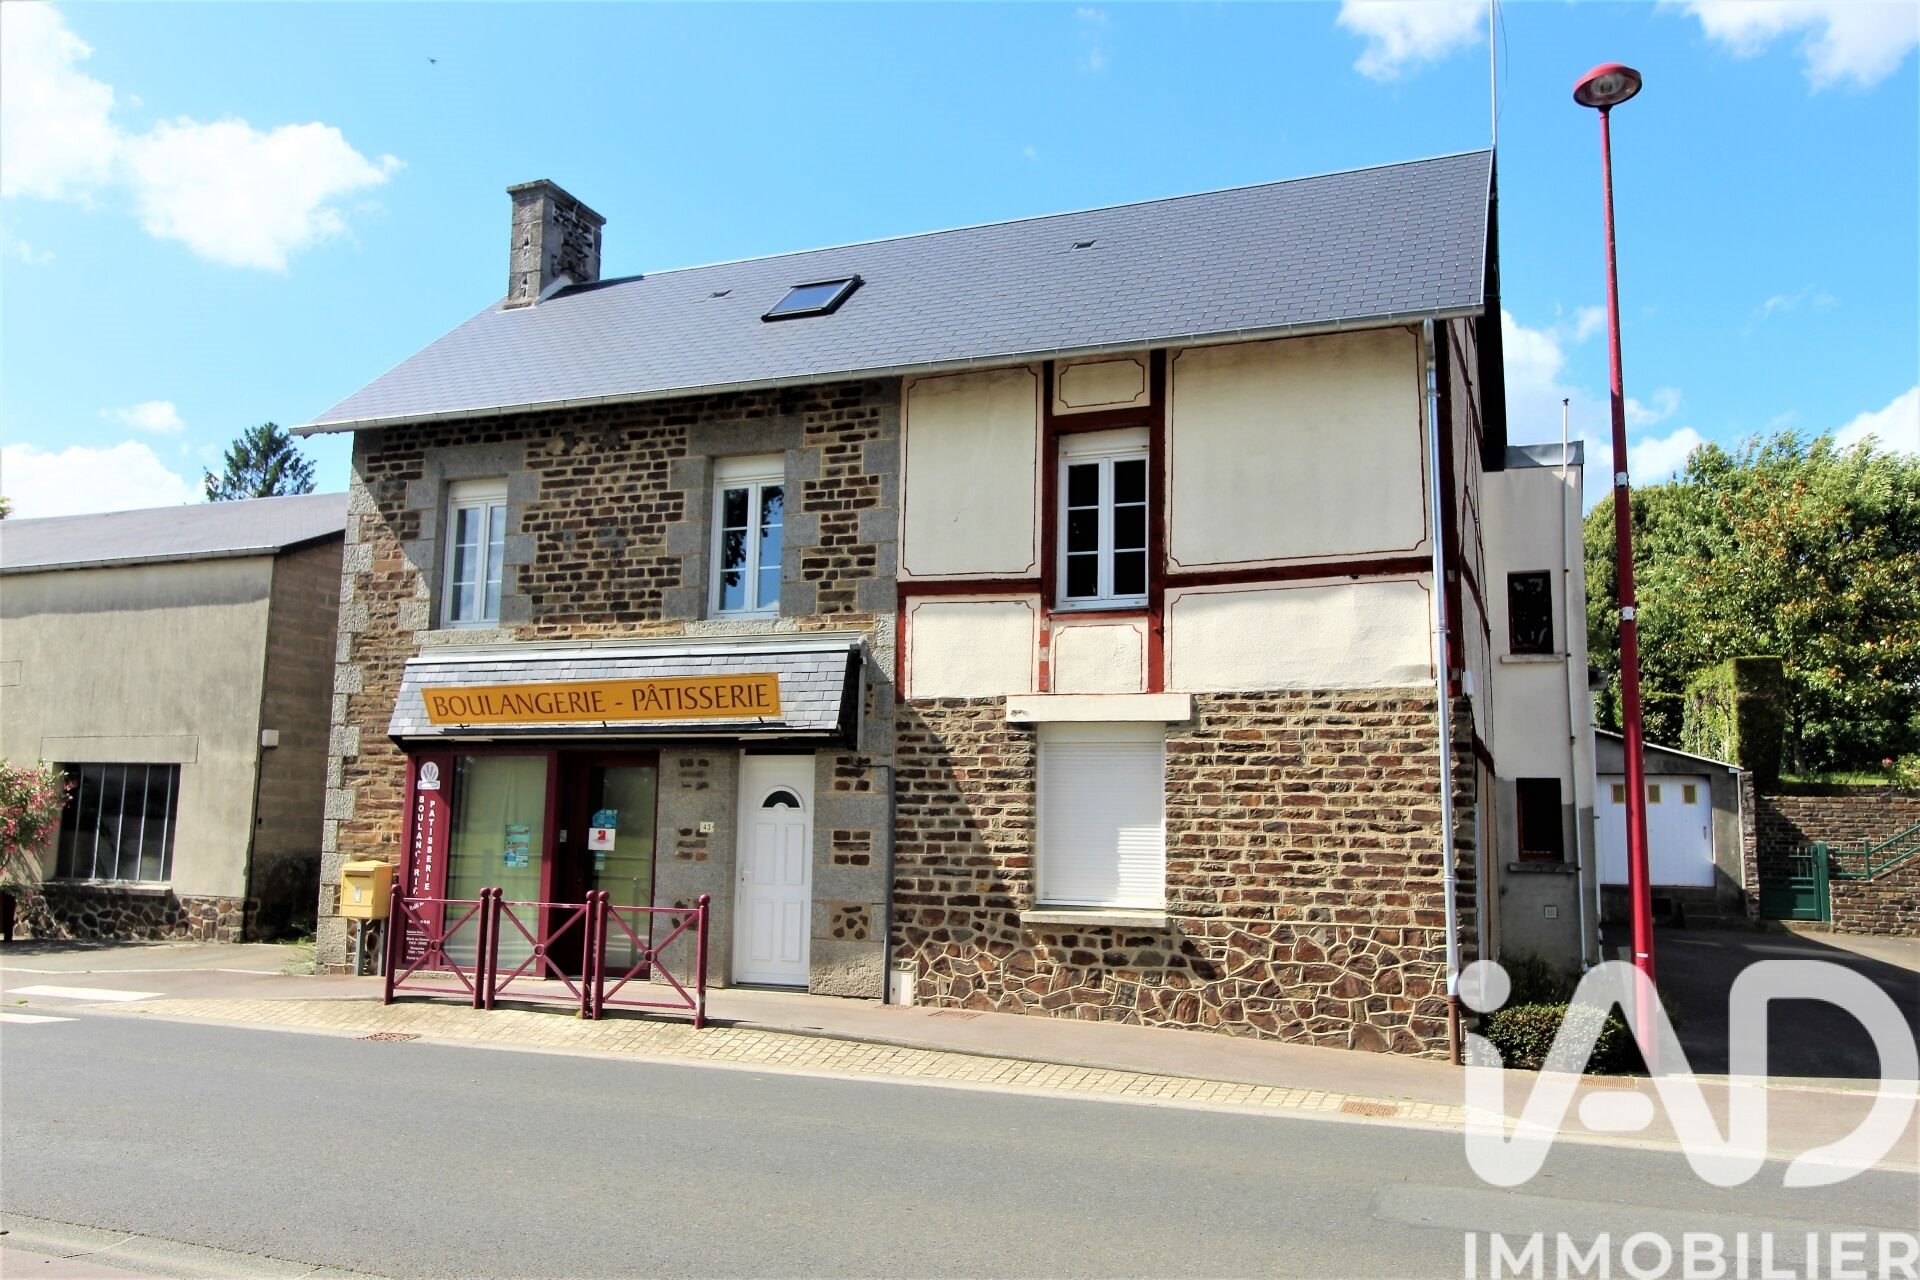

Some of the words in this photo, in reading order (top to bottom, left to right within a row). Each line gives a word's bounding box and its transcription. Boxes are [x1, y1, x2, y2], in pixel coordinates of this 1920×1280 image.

[432, 690, 607, 718] BOULANGERIE
[632, 683, 770, 712] PÂTISSERIE
[413, 796, 424, 894] BOULANRIE
[425, 800, 436, 891] PATISSERIE
